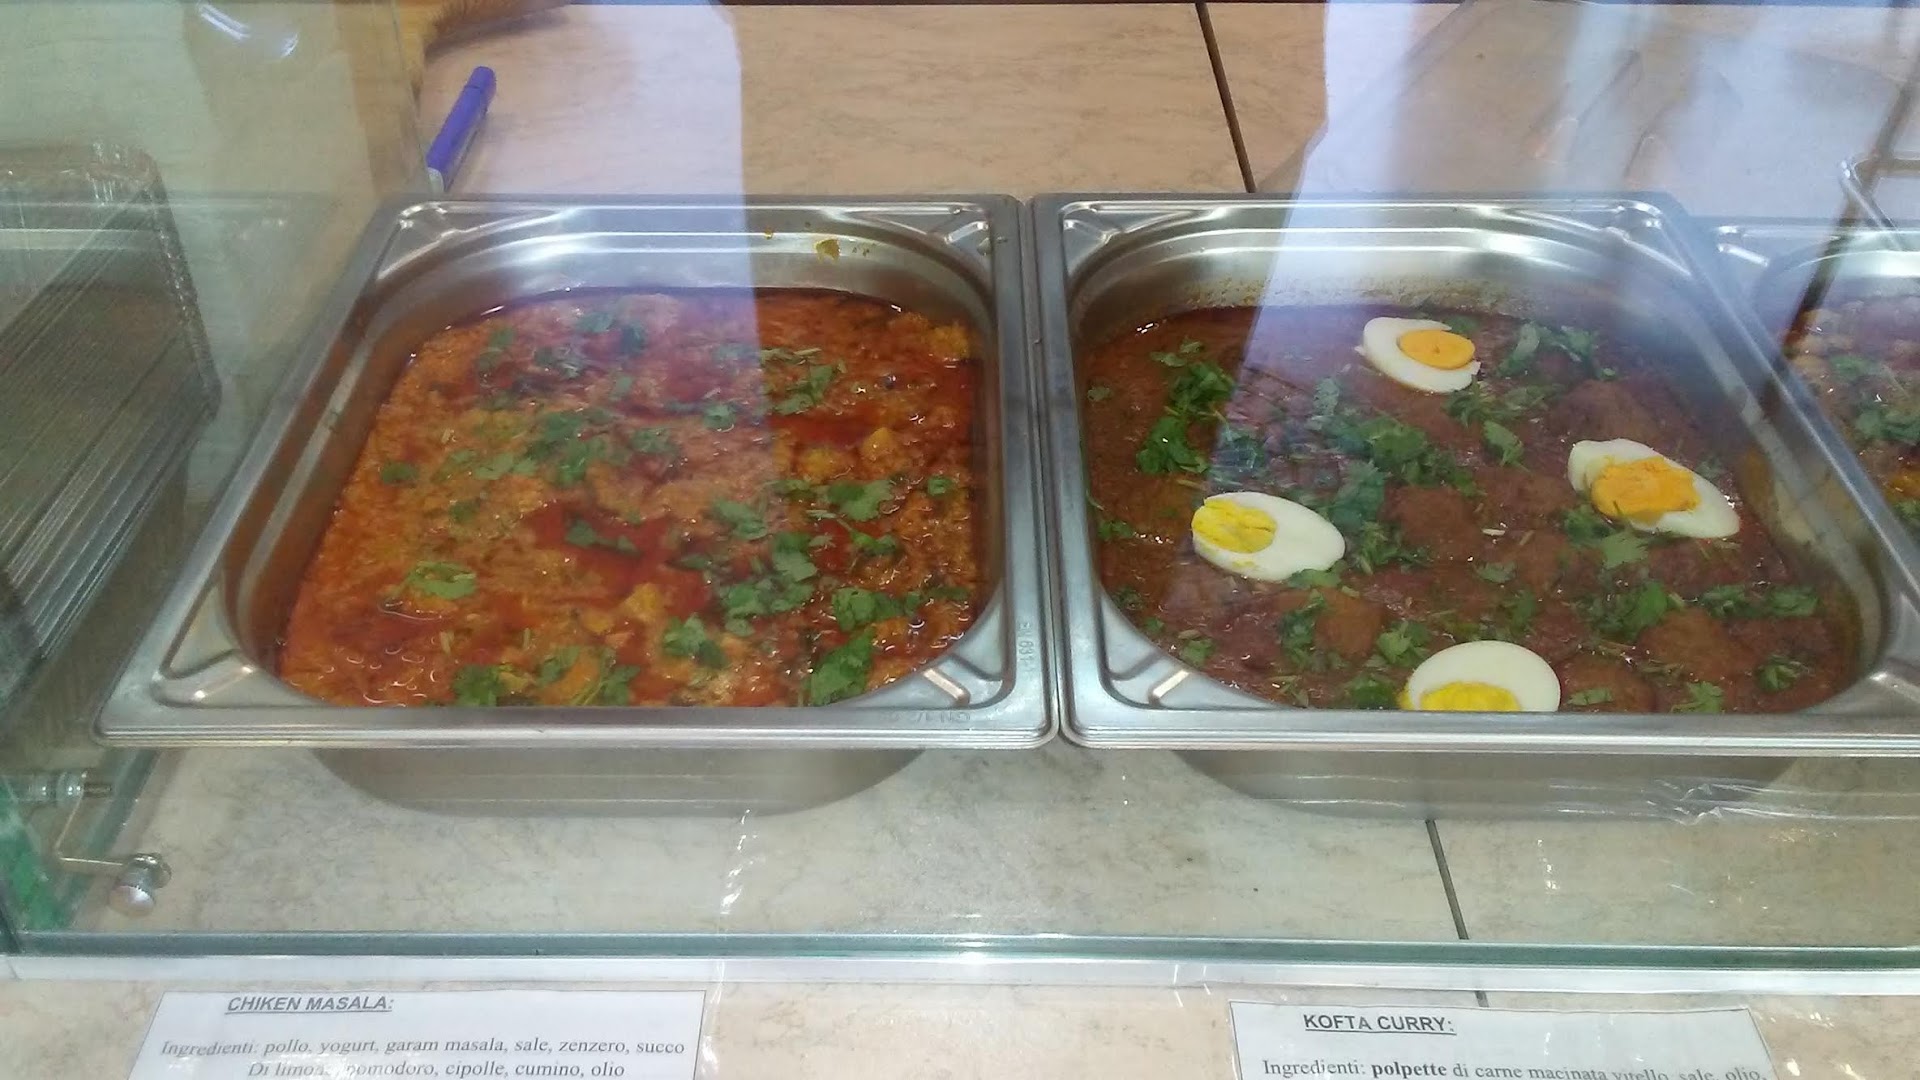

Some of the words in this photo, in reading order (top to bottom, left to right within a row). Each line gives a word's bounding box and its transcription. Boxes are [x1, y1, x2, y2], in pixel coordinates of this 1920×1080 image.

[227, 996, 300, 1012] CHIKEN
[305, 995, 395, 1011] MASALA:
[1303, 1014, 1372, 1030] KOFTA
[1377, 1016, 1455, 1033] CURRY:
[160, 1040, 259, 1058] Ingredienti:
[262, 1038, 313, 1056] pollo,
[319, 1039, 379, 1056] yogurt,
[384, 1041, 439, 1055] garam
[444, 1037, 509, 1053] masala,
[514, 1037, 553, 1054] sale,
[558, 1041, 631, 1056] zenzero,
[636, 1041, 686, 1054] succo
[247, 1061, 270, 1077] Di
[444, 1060, 509, 1079] cipolle,
[514, 1061, 585, 1078] cumino,
[591, 1061, 626, 1077] olio
[1262, 1060, 1366, 1079] Ingredienti:
[1370, 1063, 1448, 1080] polpette
[1452, 1063, 1470, 1078] di
[1475, 1066, 1523, 1078] carne
[1528, 1066, 1608, 1080] macinata
